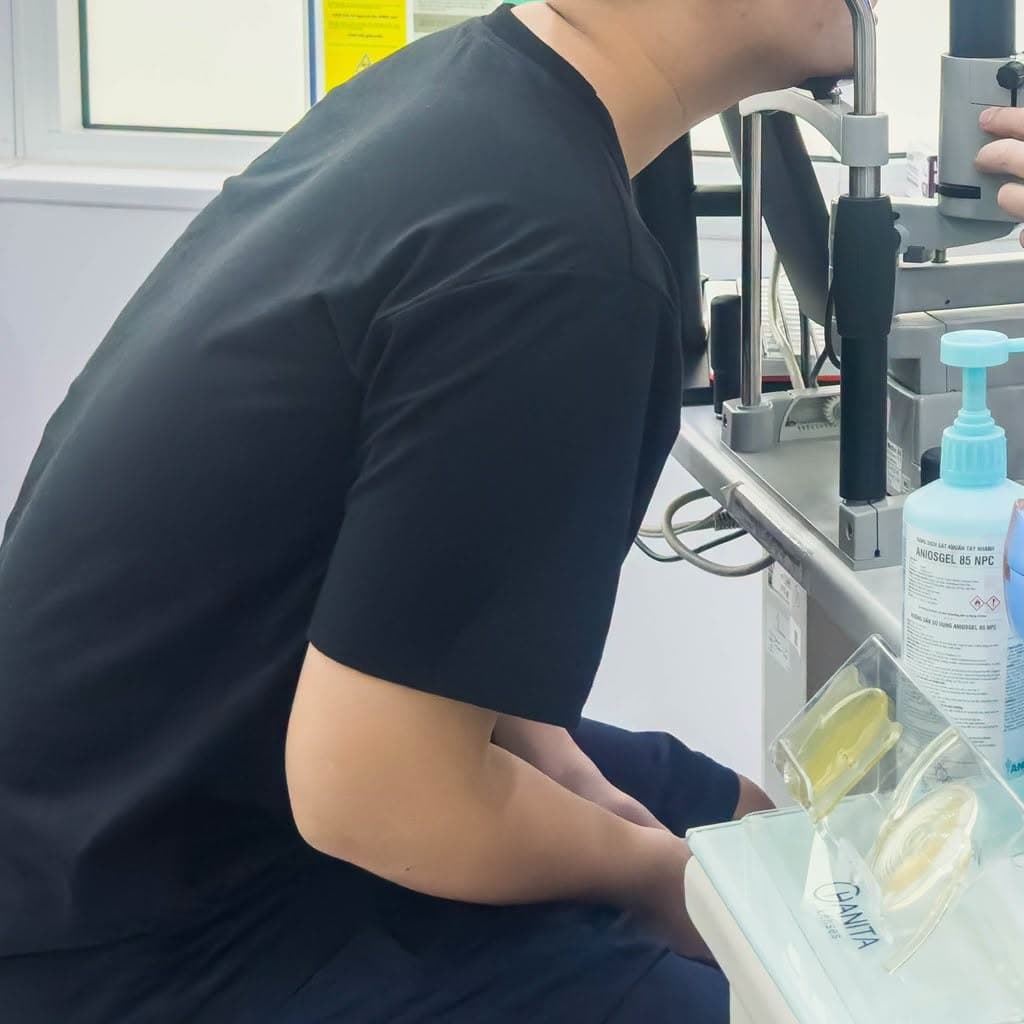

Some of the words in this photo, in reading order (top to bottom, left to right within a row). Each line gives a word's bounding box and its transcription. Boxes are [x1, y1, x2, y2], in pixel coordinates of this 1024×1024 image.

[916, 547, 956, 565] ANIOSGEL
[960, 555, 971, 566] 85
[974, 556, 994, 566] NPC
